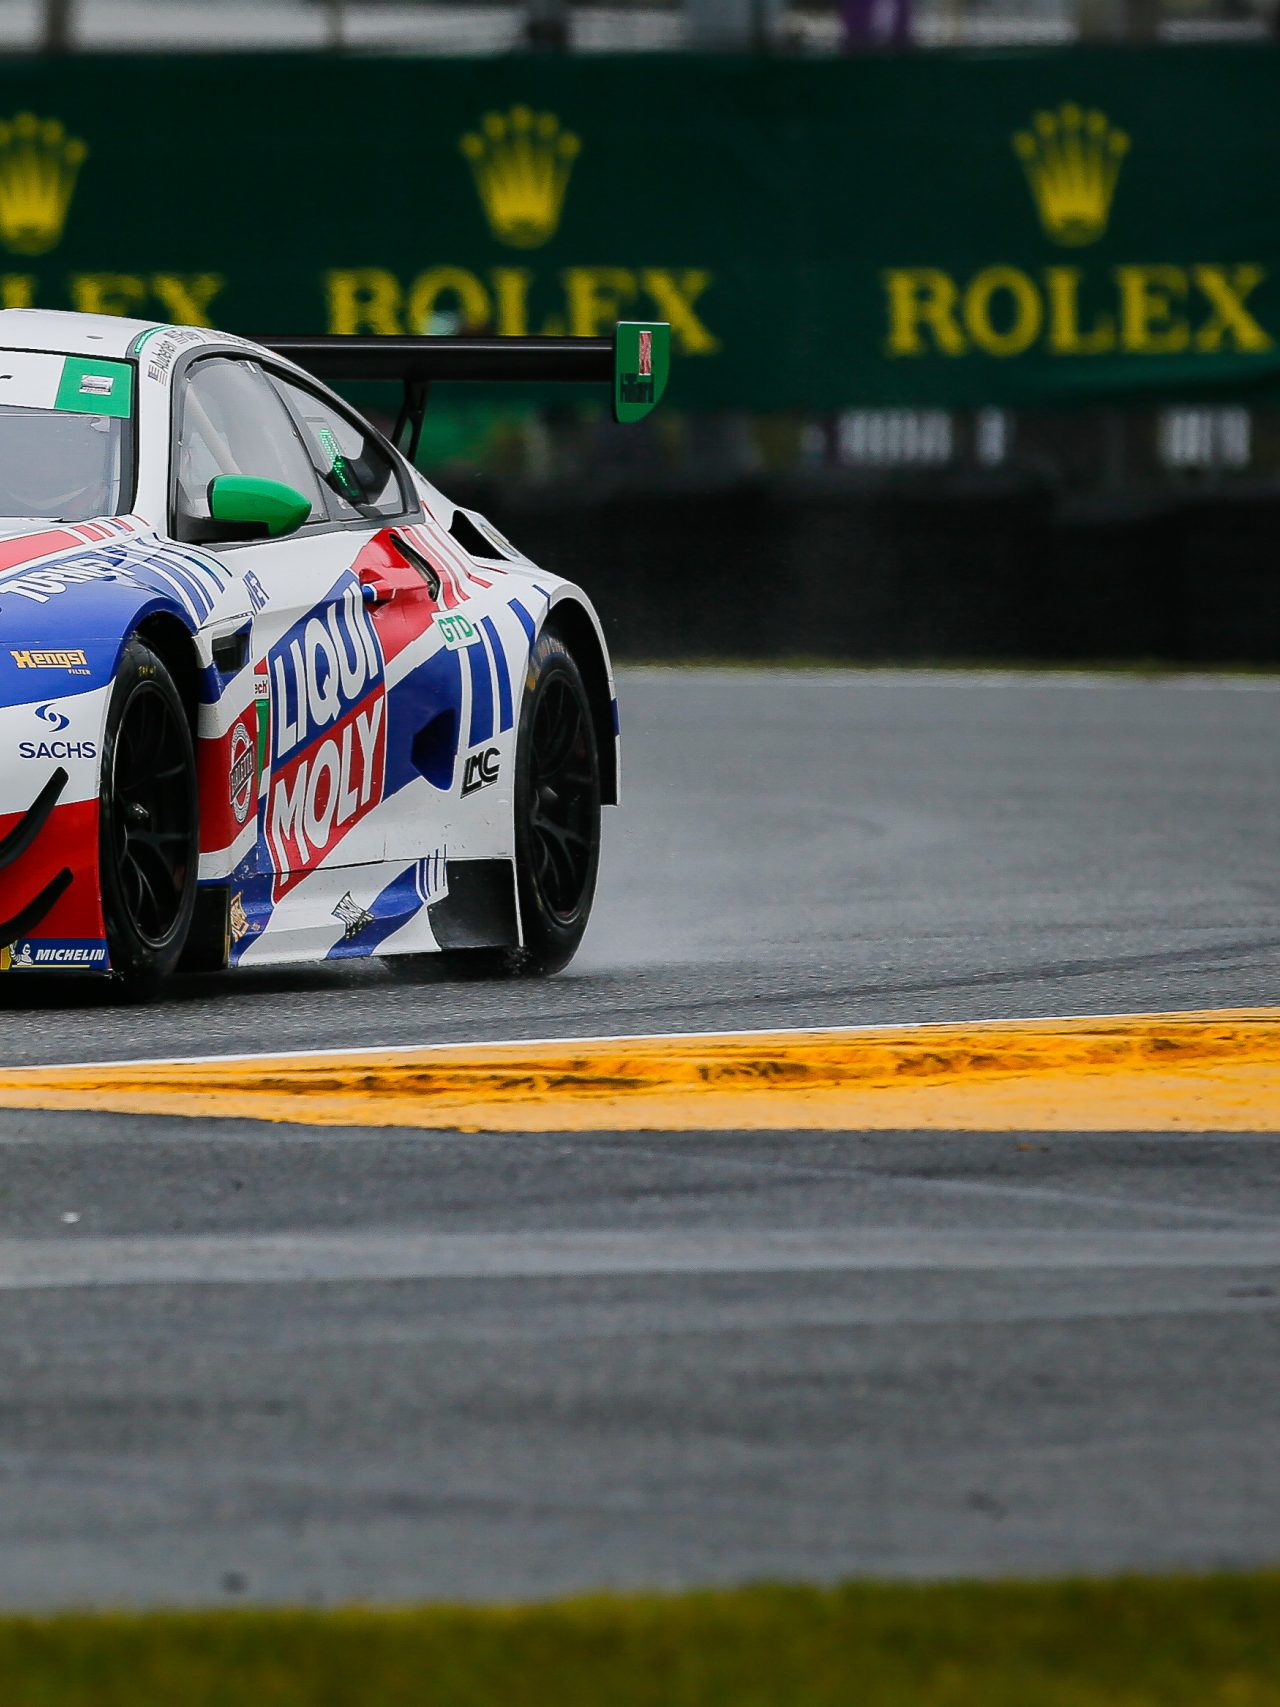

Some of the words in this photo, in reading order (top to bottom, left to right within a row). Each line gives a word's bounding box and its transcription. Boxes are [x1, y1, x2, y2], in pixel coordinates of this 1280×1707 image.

[884, 264, 1271, 357] ROLEX
[438, 614, 475, 643] GTD
[10, 649, 88, 668] Hengst
[274, 581, 378, 759] LIQUI
[19, 741, 97, 760] SACHS
[271, 694, 385, 884] MOLY
[35, 949, 106, 961] MICHELIN
